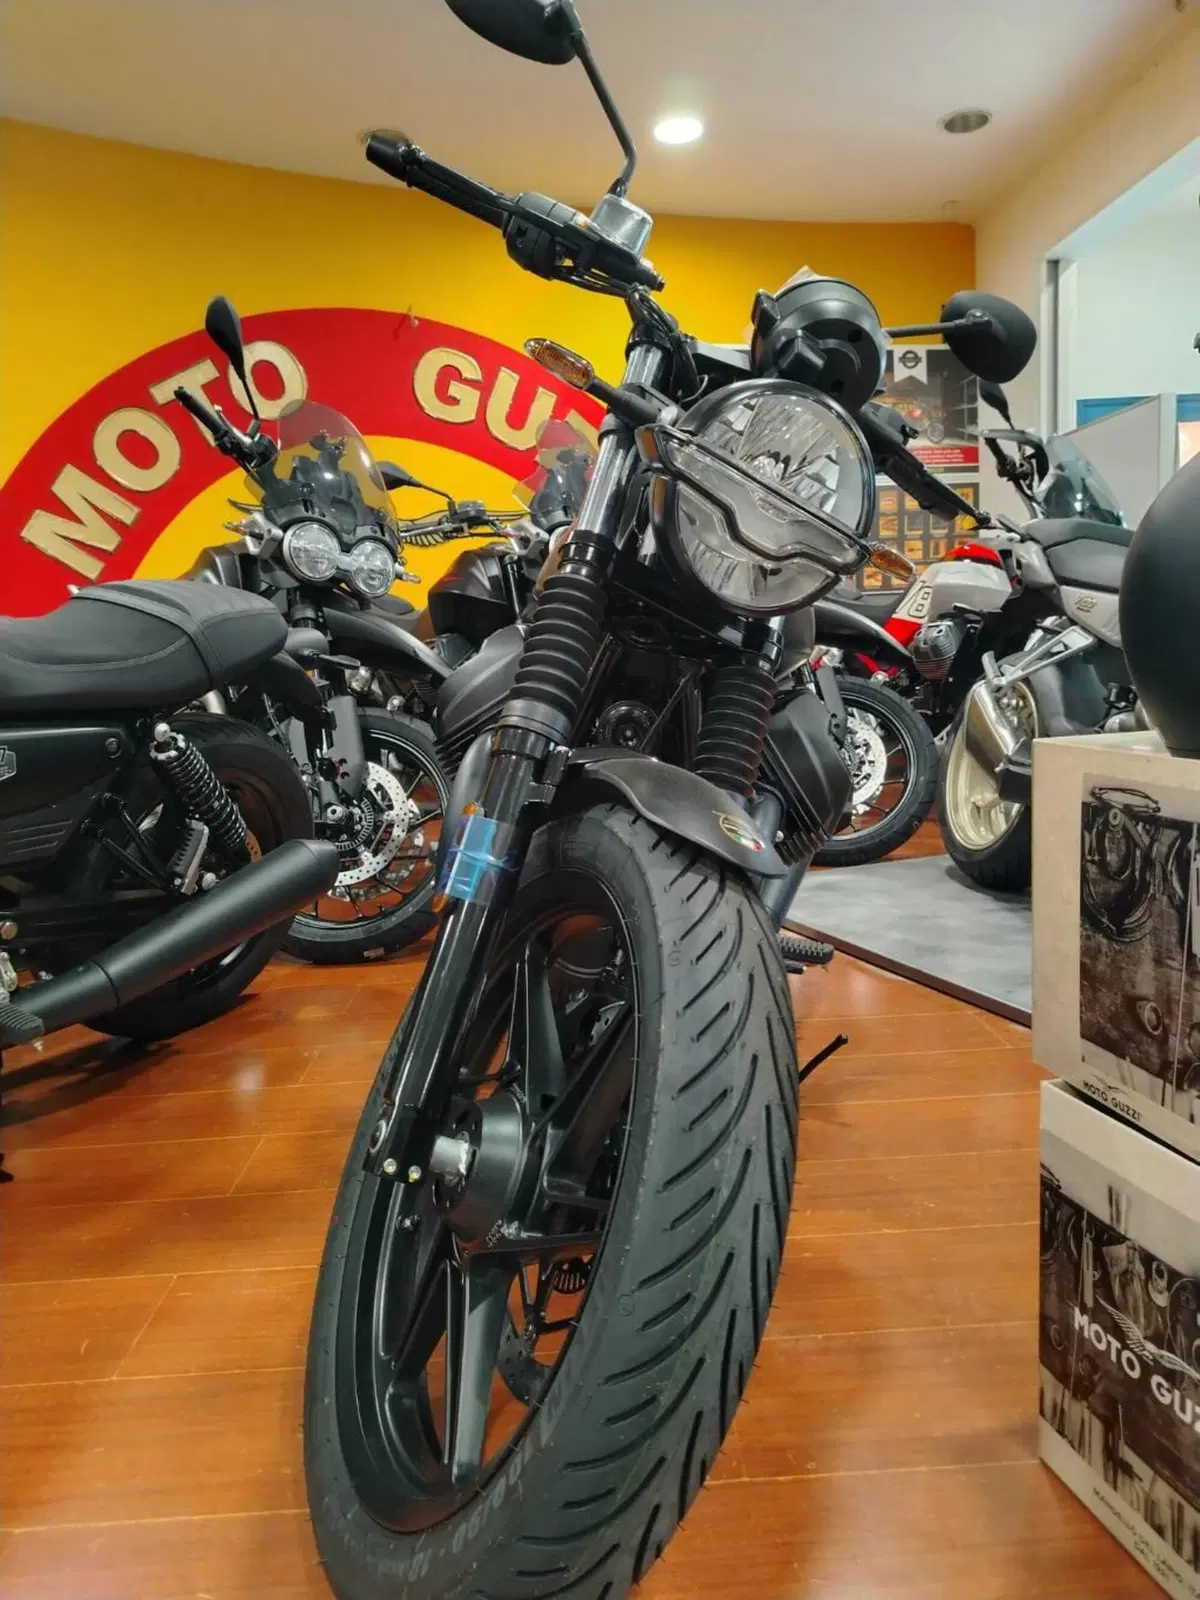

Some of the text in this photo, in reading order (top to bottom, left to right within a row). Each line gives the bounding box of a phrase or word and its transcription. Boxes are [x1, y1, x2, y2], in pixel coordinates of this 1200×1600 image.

[20, 340, 309, 582] MOTO
[1083, 1081, 1142, 1121] MOTO GUZZI
[1074, 1306, 1141, 1379] MOTO
